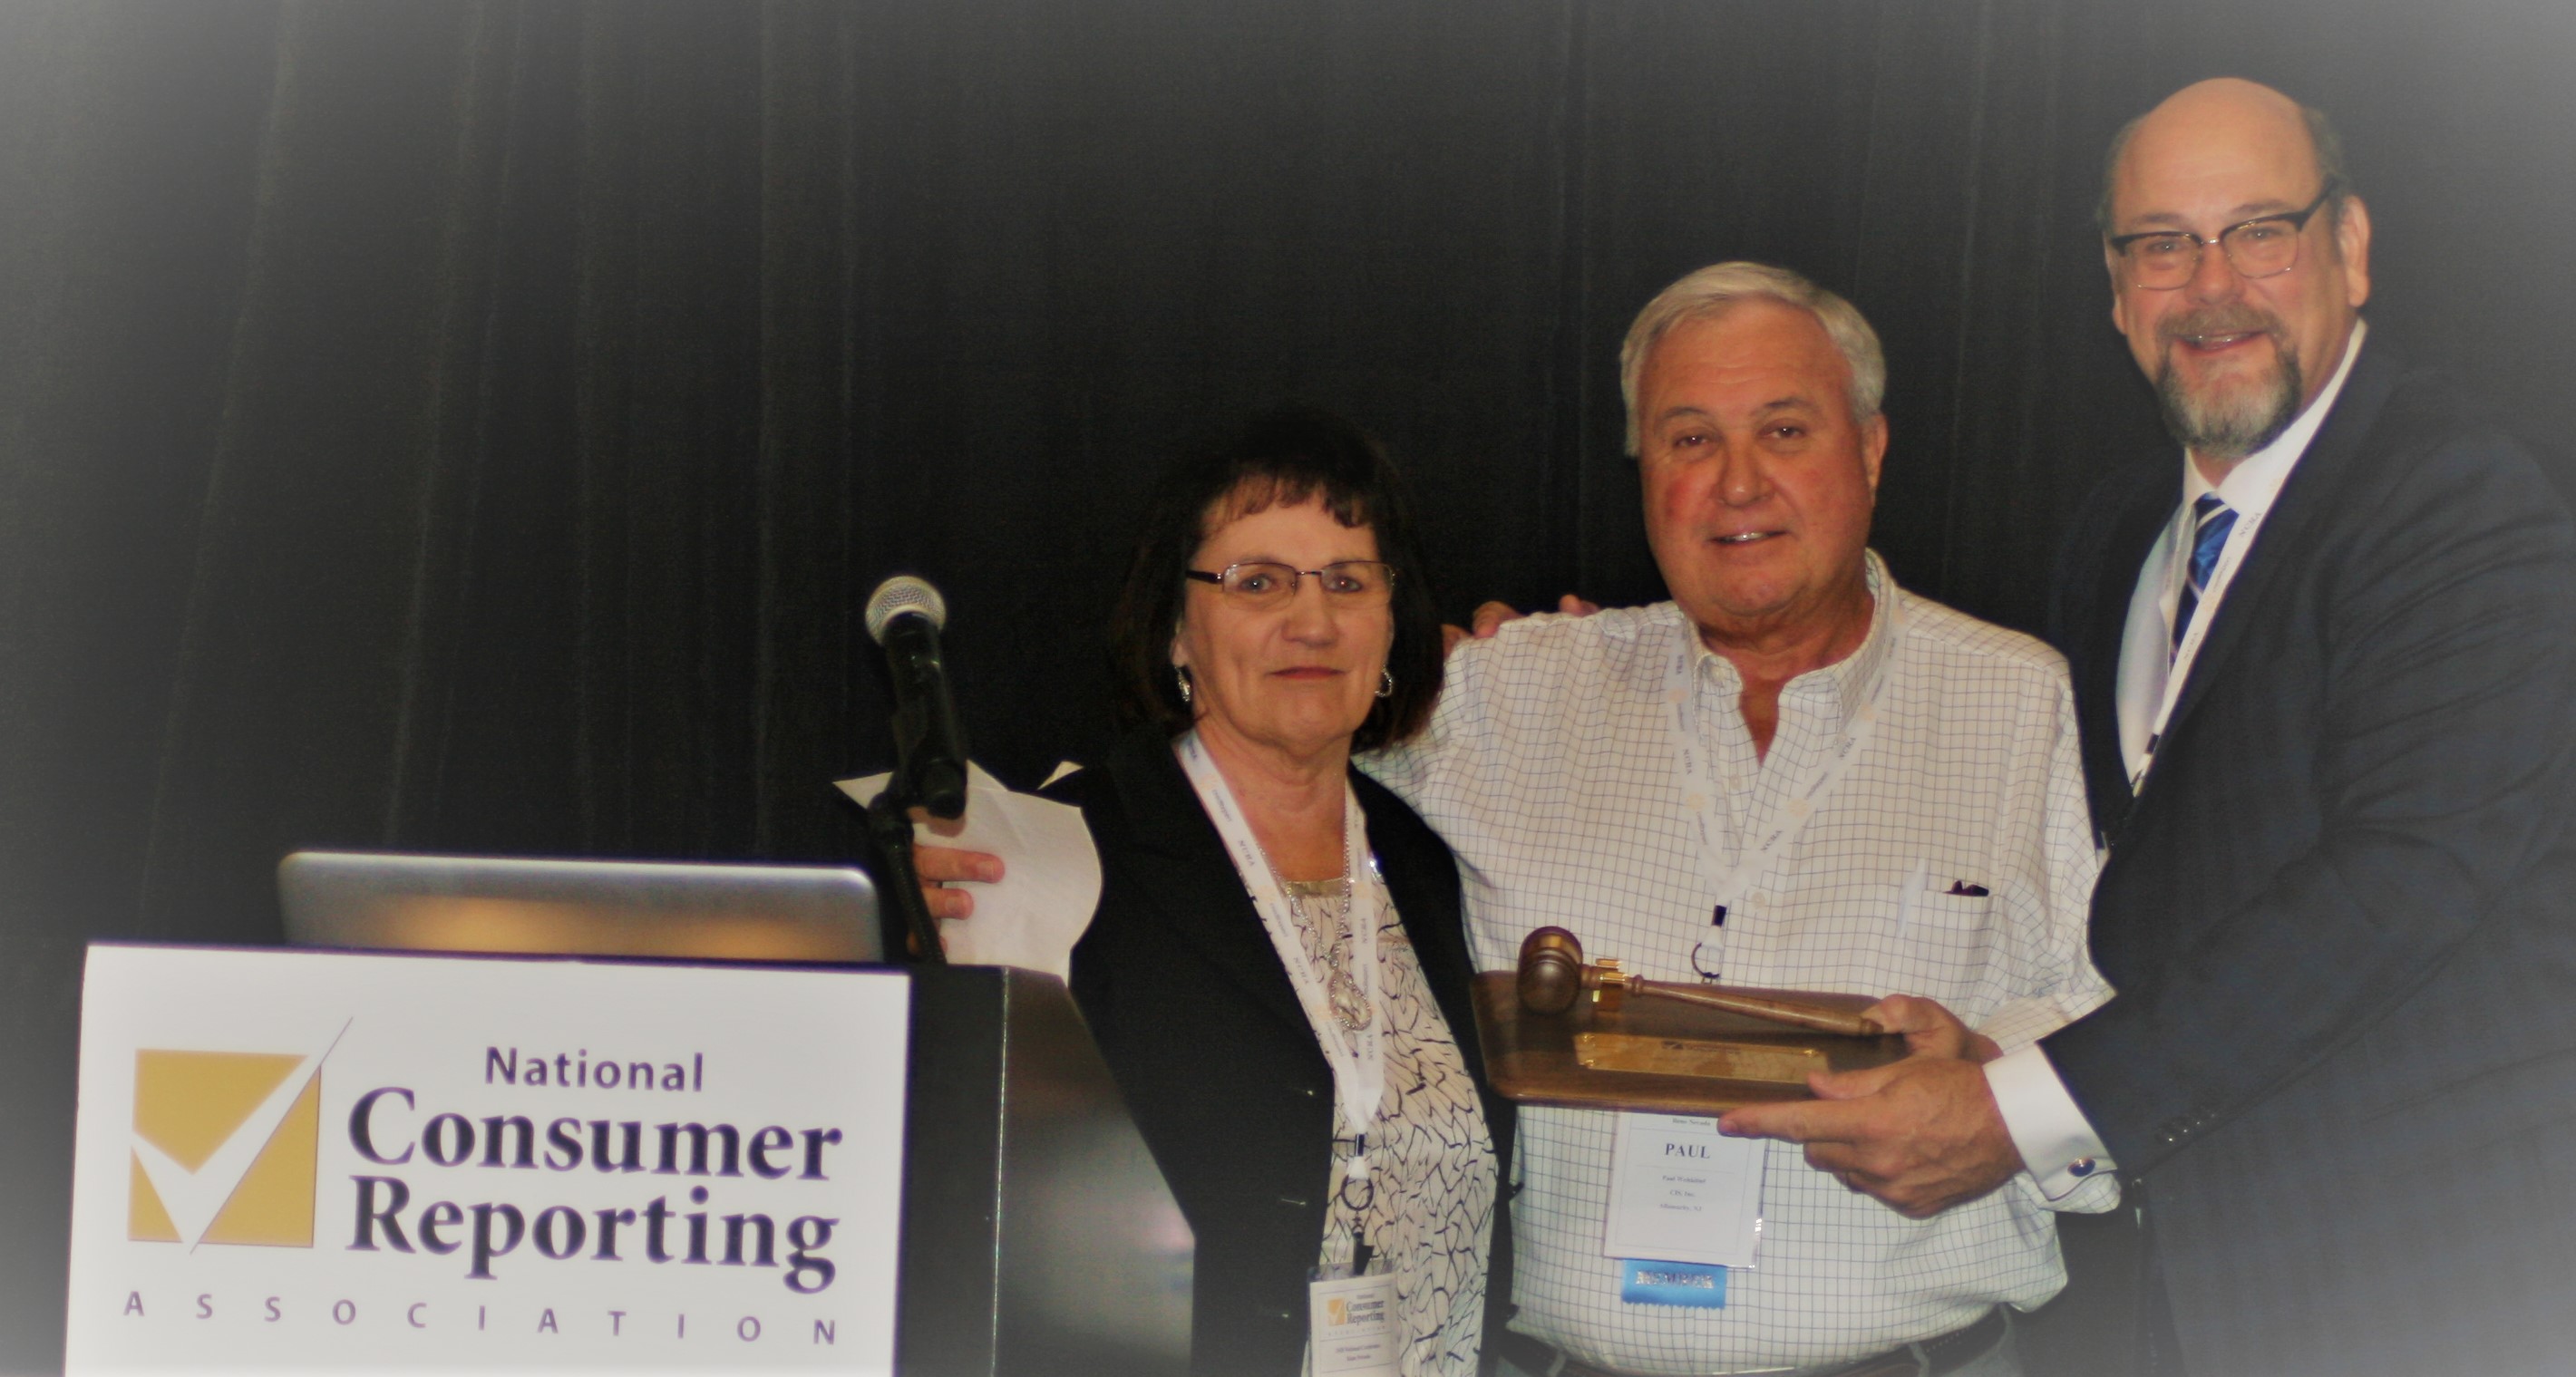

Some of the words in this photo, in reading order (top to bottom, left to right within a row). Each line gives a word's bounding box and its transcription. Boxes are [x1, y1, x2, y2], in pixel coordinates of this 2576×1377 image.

[484, 1046, 705, 1092] National
[347, 1086, 843, 1182] Consumer
[1665, 1142, 1711, 1159] PAUL
[345, 1174, 841, 1295] Reporting
[122, 1290, 837, 1345] ASSOCIATION
[1346, 1310, 1385, 1326] Reporting
